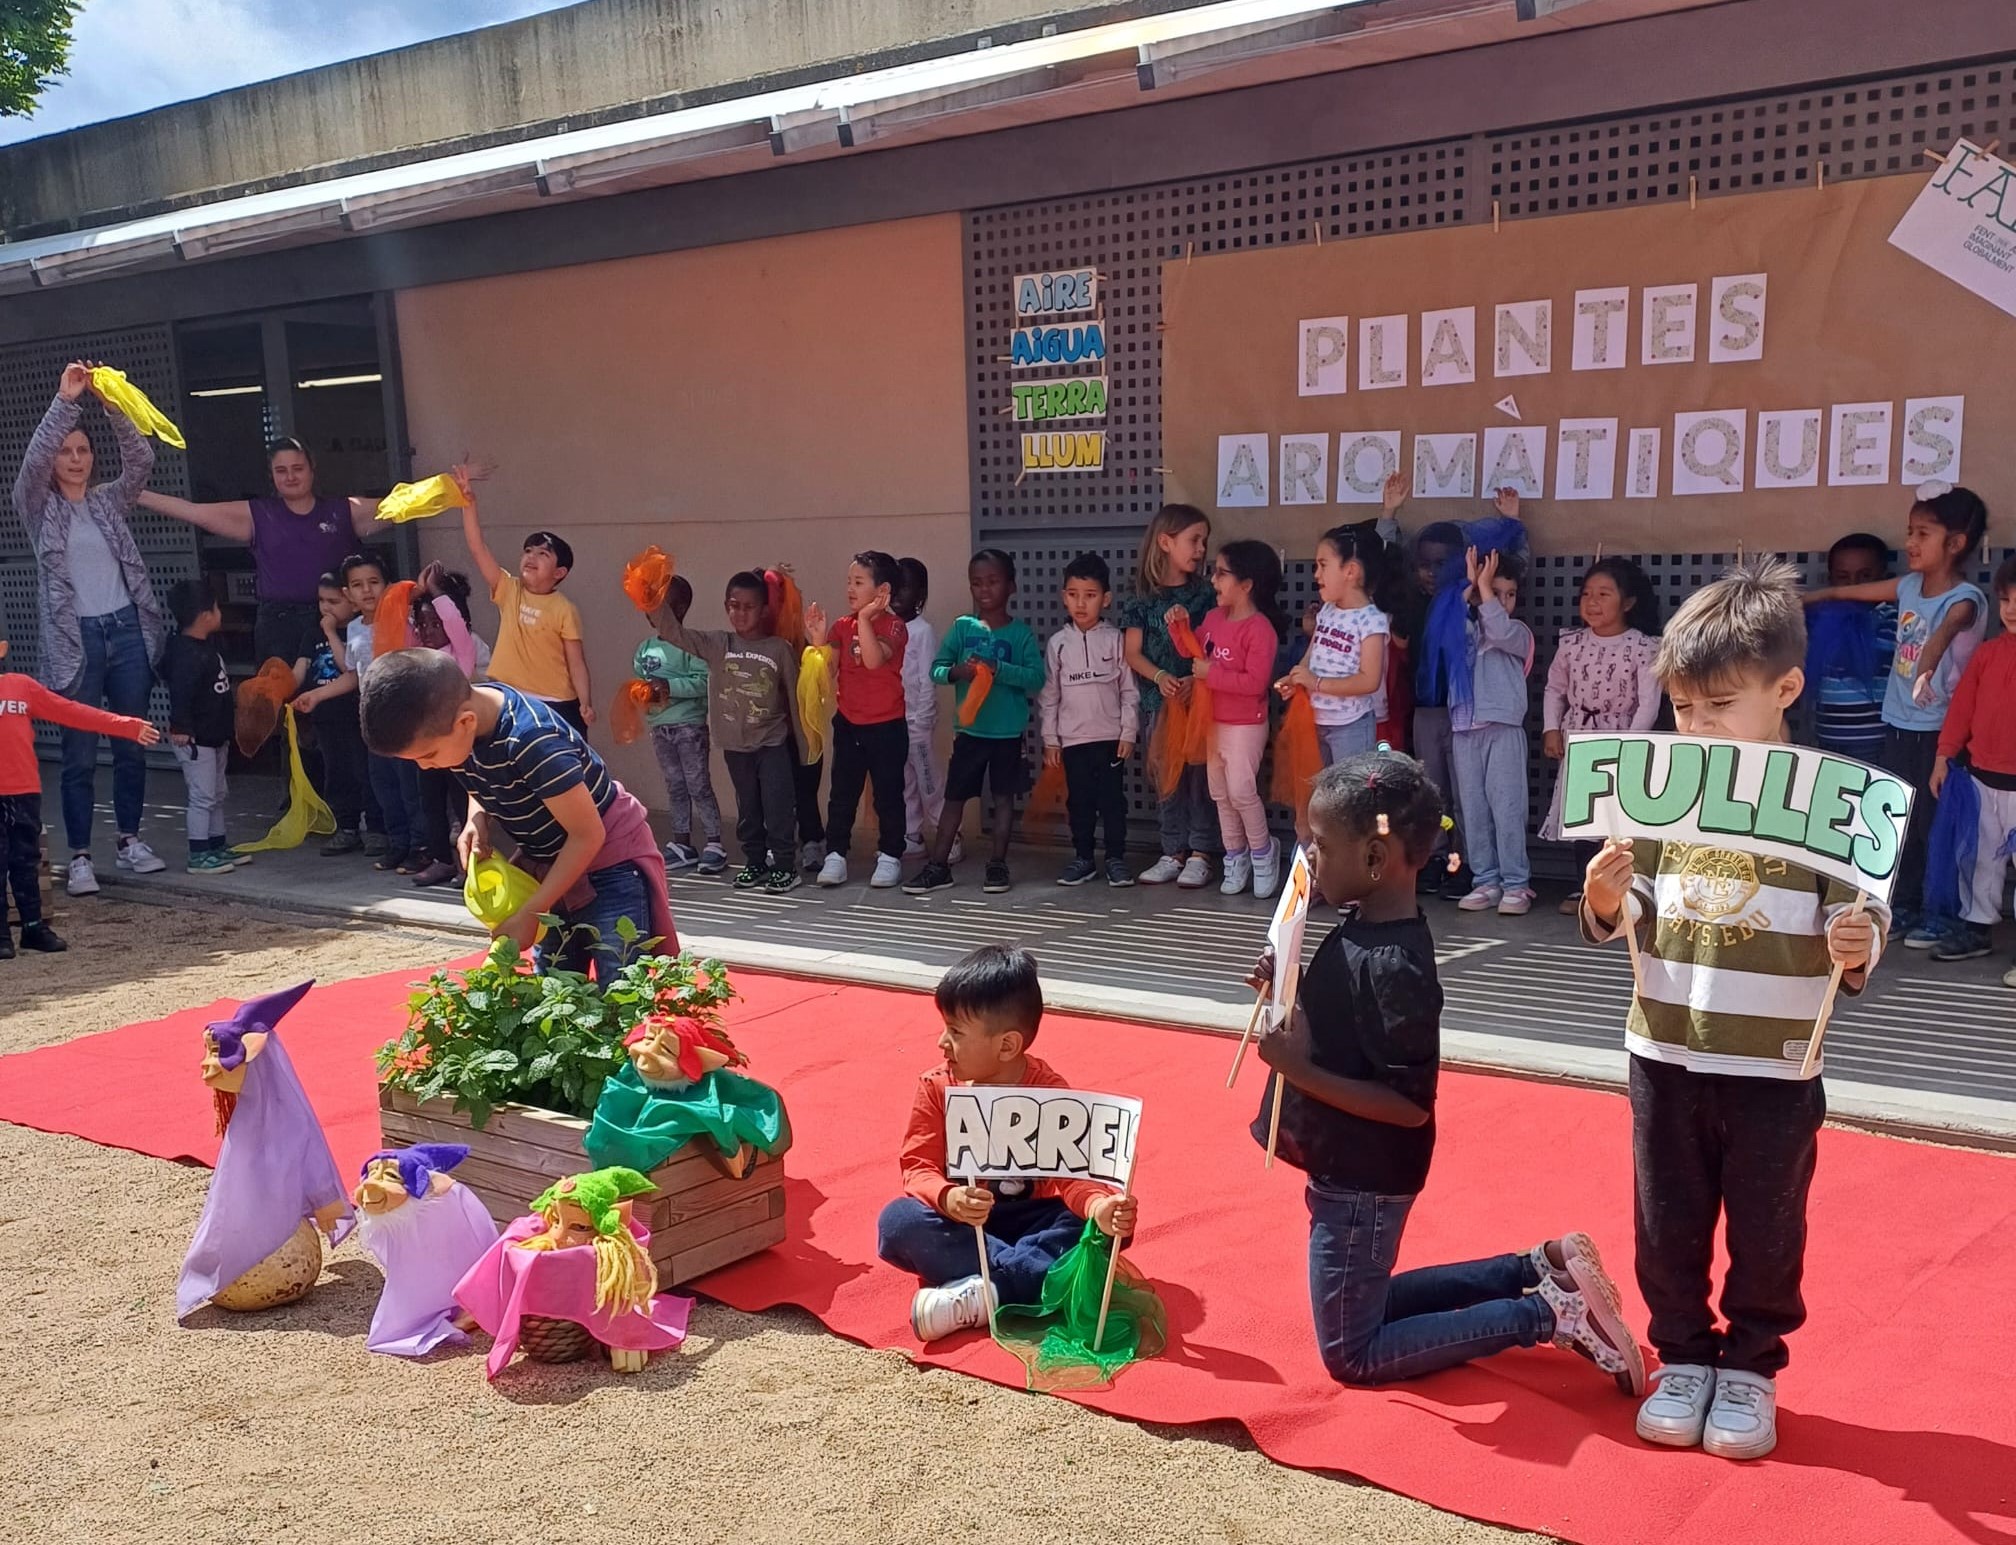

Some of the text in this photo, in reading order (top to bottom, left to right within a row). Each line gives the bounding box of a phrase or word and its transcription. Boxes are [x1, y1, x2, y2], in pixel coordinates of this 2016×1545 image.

[1931, 144, 2016, 233] FA
[1968, 232, 2012, 260] IMAGINANT
[1974, 224, 1996, 240] FENT
[1963, 240, 2015, 273] GLOBALMENT
[1305, 282, 1764, 388] PLANTES
[1012, 380, 1108, 421] TERRA
[1023, 433, 1104, 469] LLUM
[1069, 672, 1092, 682] NIKE
[1563, 738, 1908, 880] FULLES
[946, 1094, 1140, 1186] ARREL
